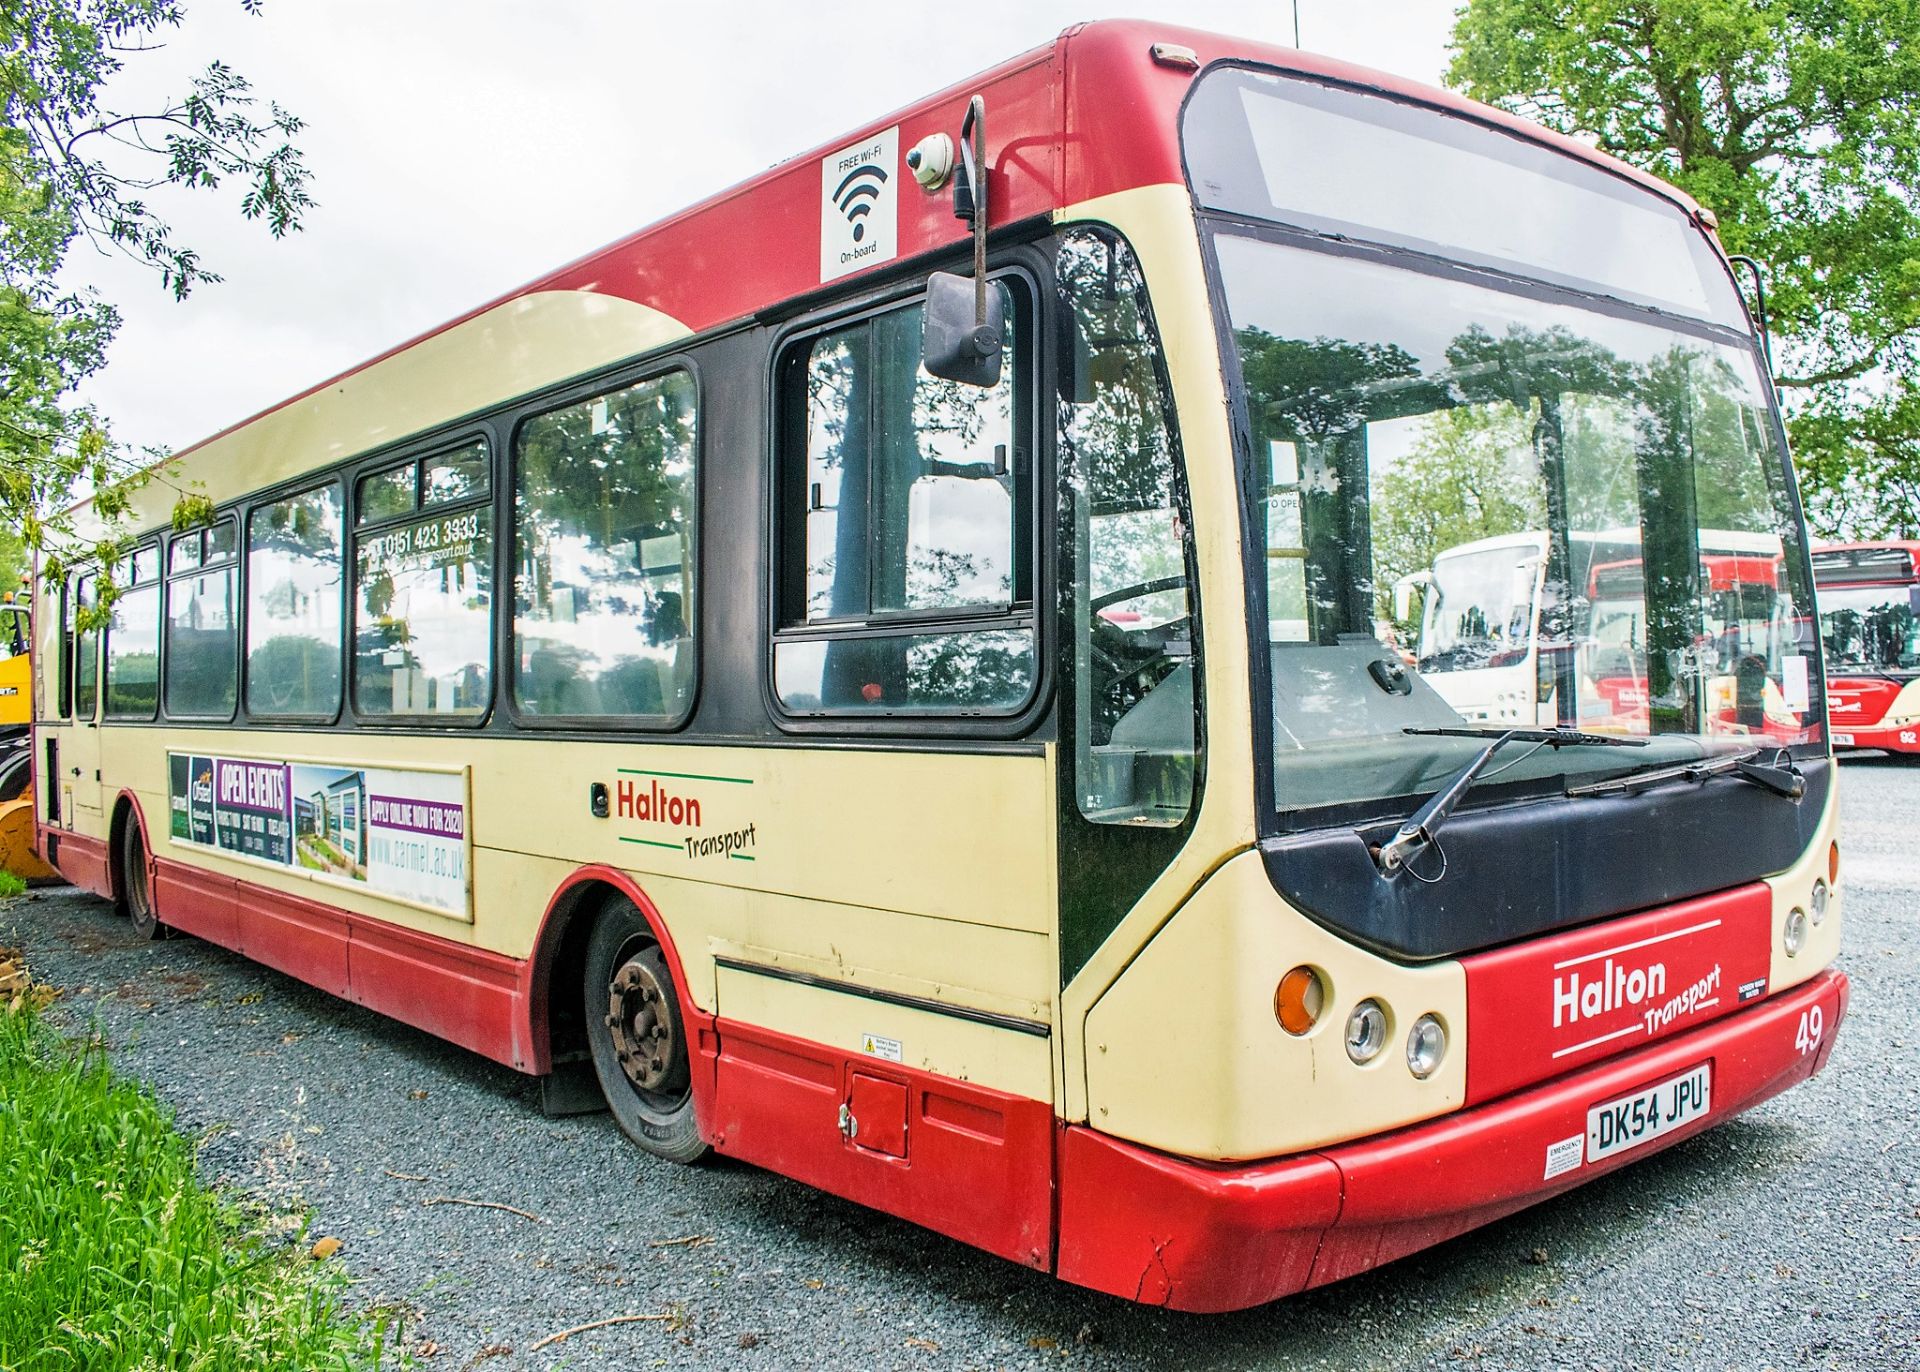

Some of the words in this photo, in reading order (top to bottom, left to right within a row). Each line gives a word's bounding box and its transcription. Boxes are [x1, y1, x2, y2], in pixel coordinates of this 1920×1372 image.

[838, 154, 859, 173] FREE
[860, 143, 882, 163] Wi-Fi
[840, 240, 877, 264] On-board
[386, 530, 411, 556] 0151
[415, 523, 439, 549] 423
[443, 514, 477, 544] 3333
[1900, 731, 1917, 744] 92
[222, 764, 247, 804] OPEN
[248, 766, 284, 811] EVENTS
[617, 780, 701, 827] Halton
[372, 800, 389, 823] APPLY
[390, 802, 413, 827] ONLINE
[413, 805, 429, 829] NOW
[429, 807, 444, 832] FOR
[444, 809, 462, 834] 2020
[369, 837, 465, 881] www.carmel.ac.uk
[685, 822, 756, 860] Transport
[1553, 958, 1666, 1028] Halton
[1644, 963, 1721, 1035] Transport
[1794, 1004, 1823, 1056] 49
[1598, 1092, 1660, 1151] DK54
[1666, 1073, 1702, 1122] JPU
[1550, 1138, 1582, 1157] EMERGENCY
